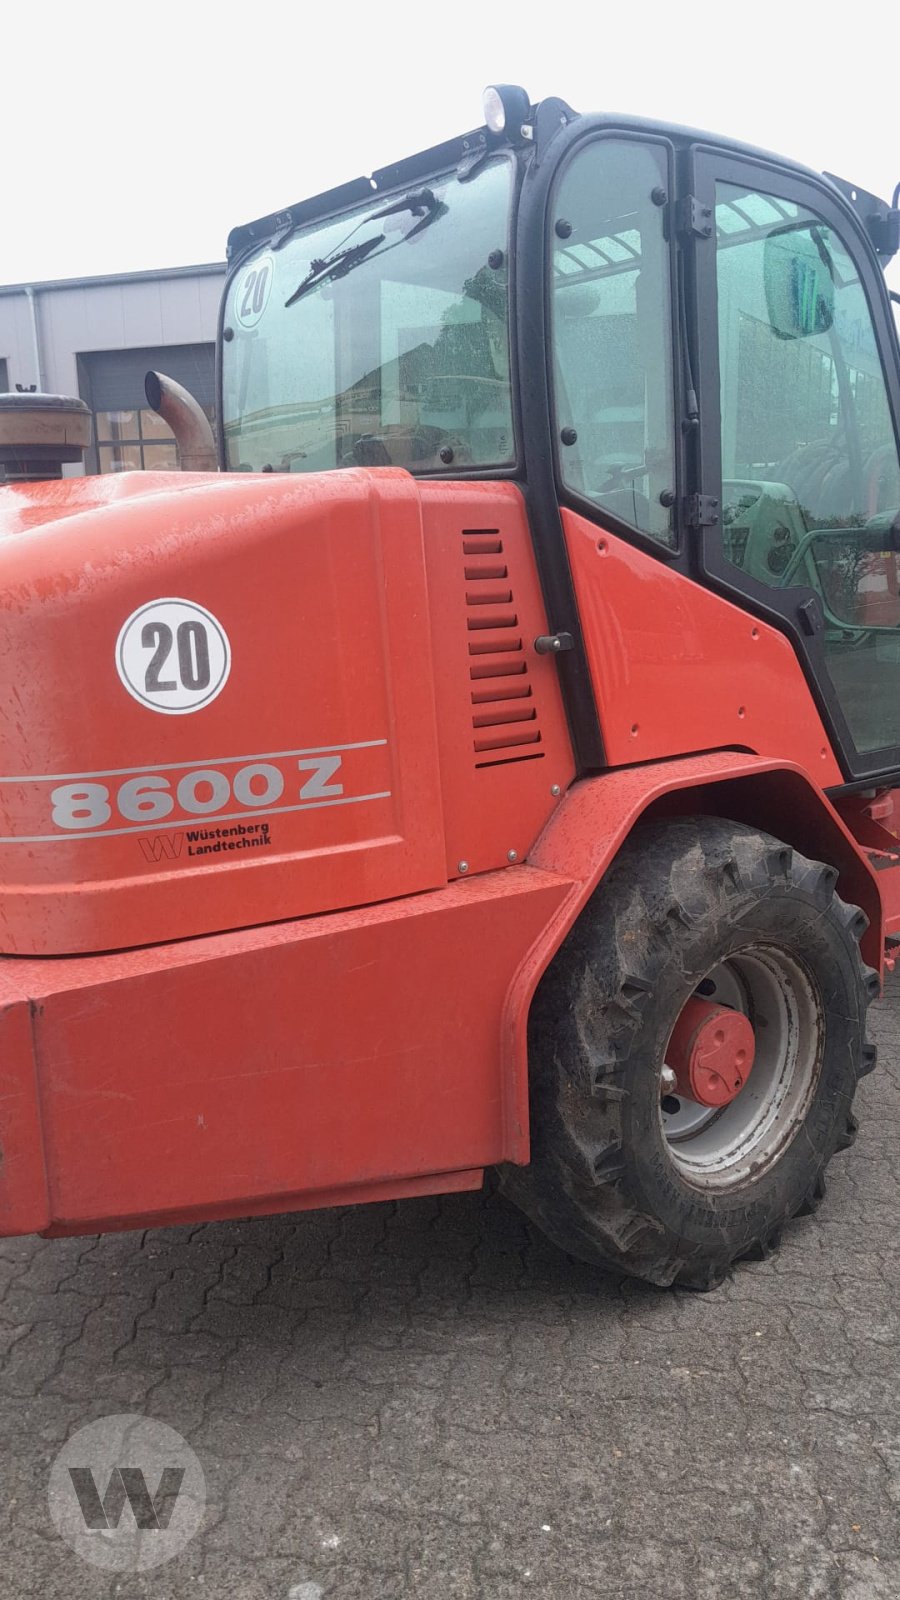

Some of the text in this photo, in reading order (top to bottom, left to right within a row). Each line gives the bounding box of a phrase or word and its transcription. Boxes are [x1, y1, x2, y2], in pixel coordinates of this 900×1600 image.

[241, 266, 269, 317] 20
[141, 620, 211, 693] 20
[50, 755, 344, 829] 8600 Z
[186, 823, 269, 842] Wüstenberg
[188, 834, 271, 856] Landtechnik
